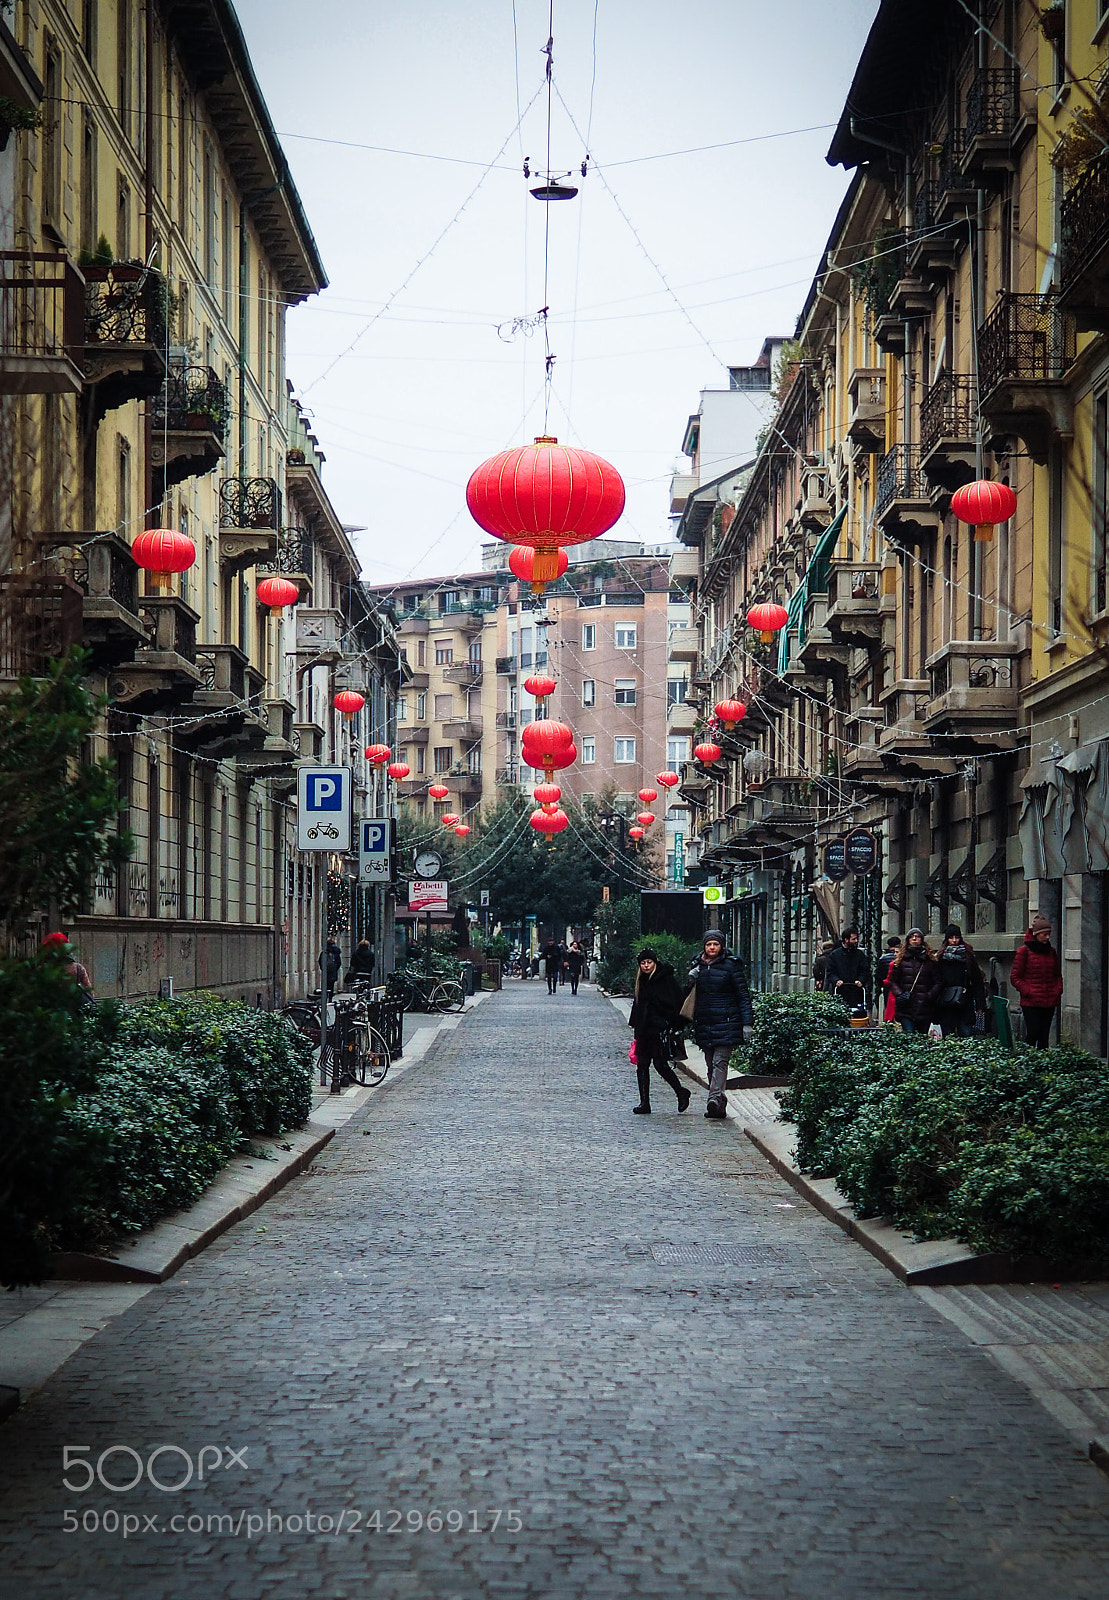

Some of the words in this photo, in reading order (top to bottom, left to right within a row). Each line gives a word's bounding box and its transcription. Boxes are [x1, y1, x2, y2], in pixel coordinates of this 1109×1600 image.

[314, 777, 336, 807] P
[368, 826, 382, 849] P
[413, 882, 443, 893] gabetti
